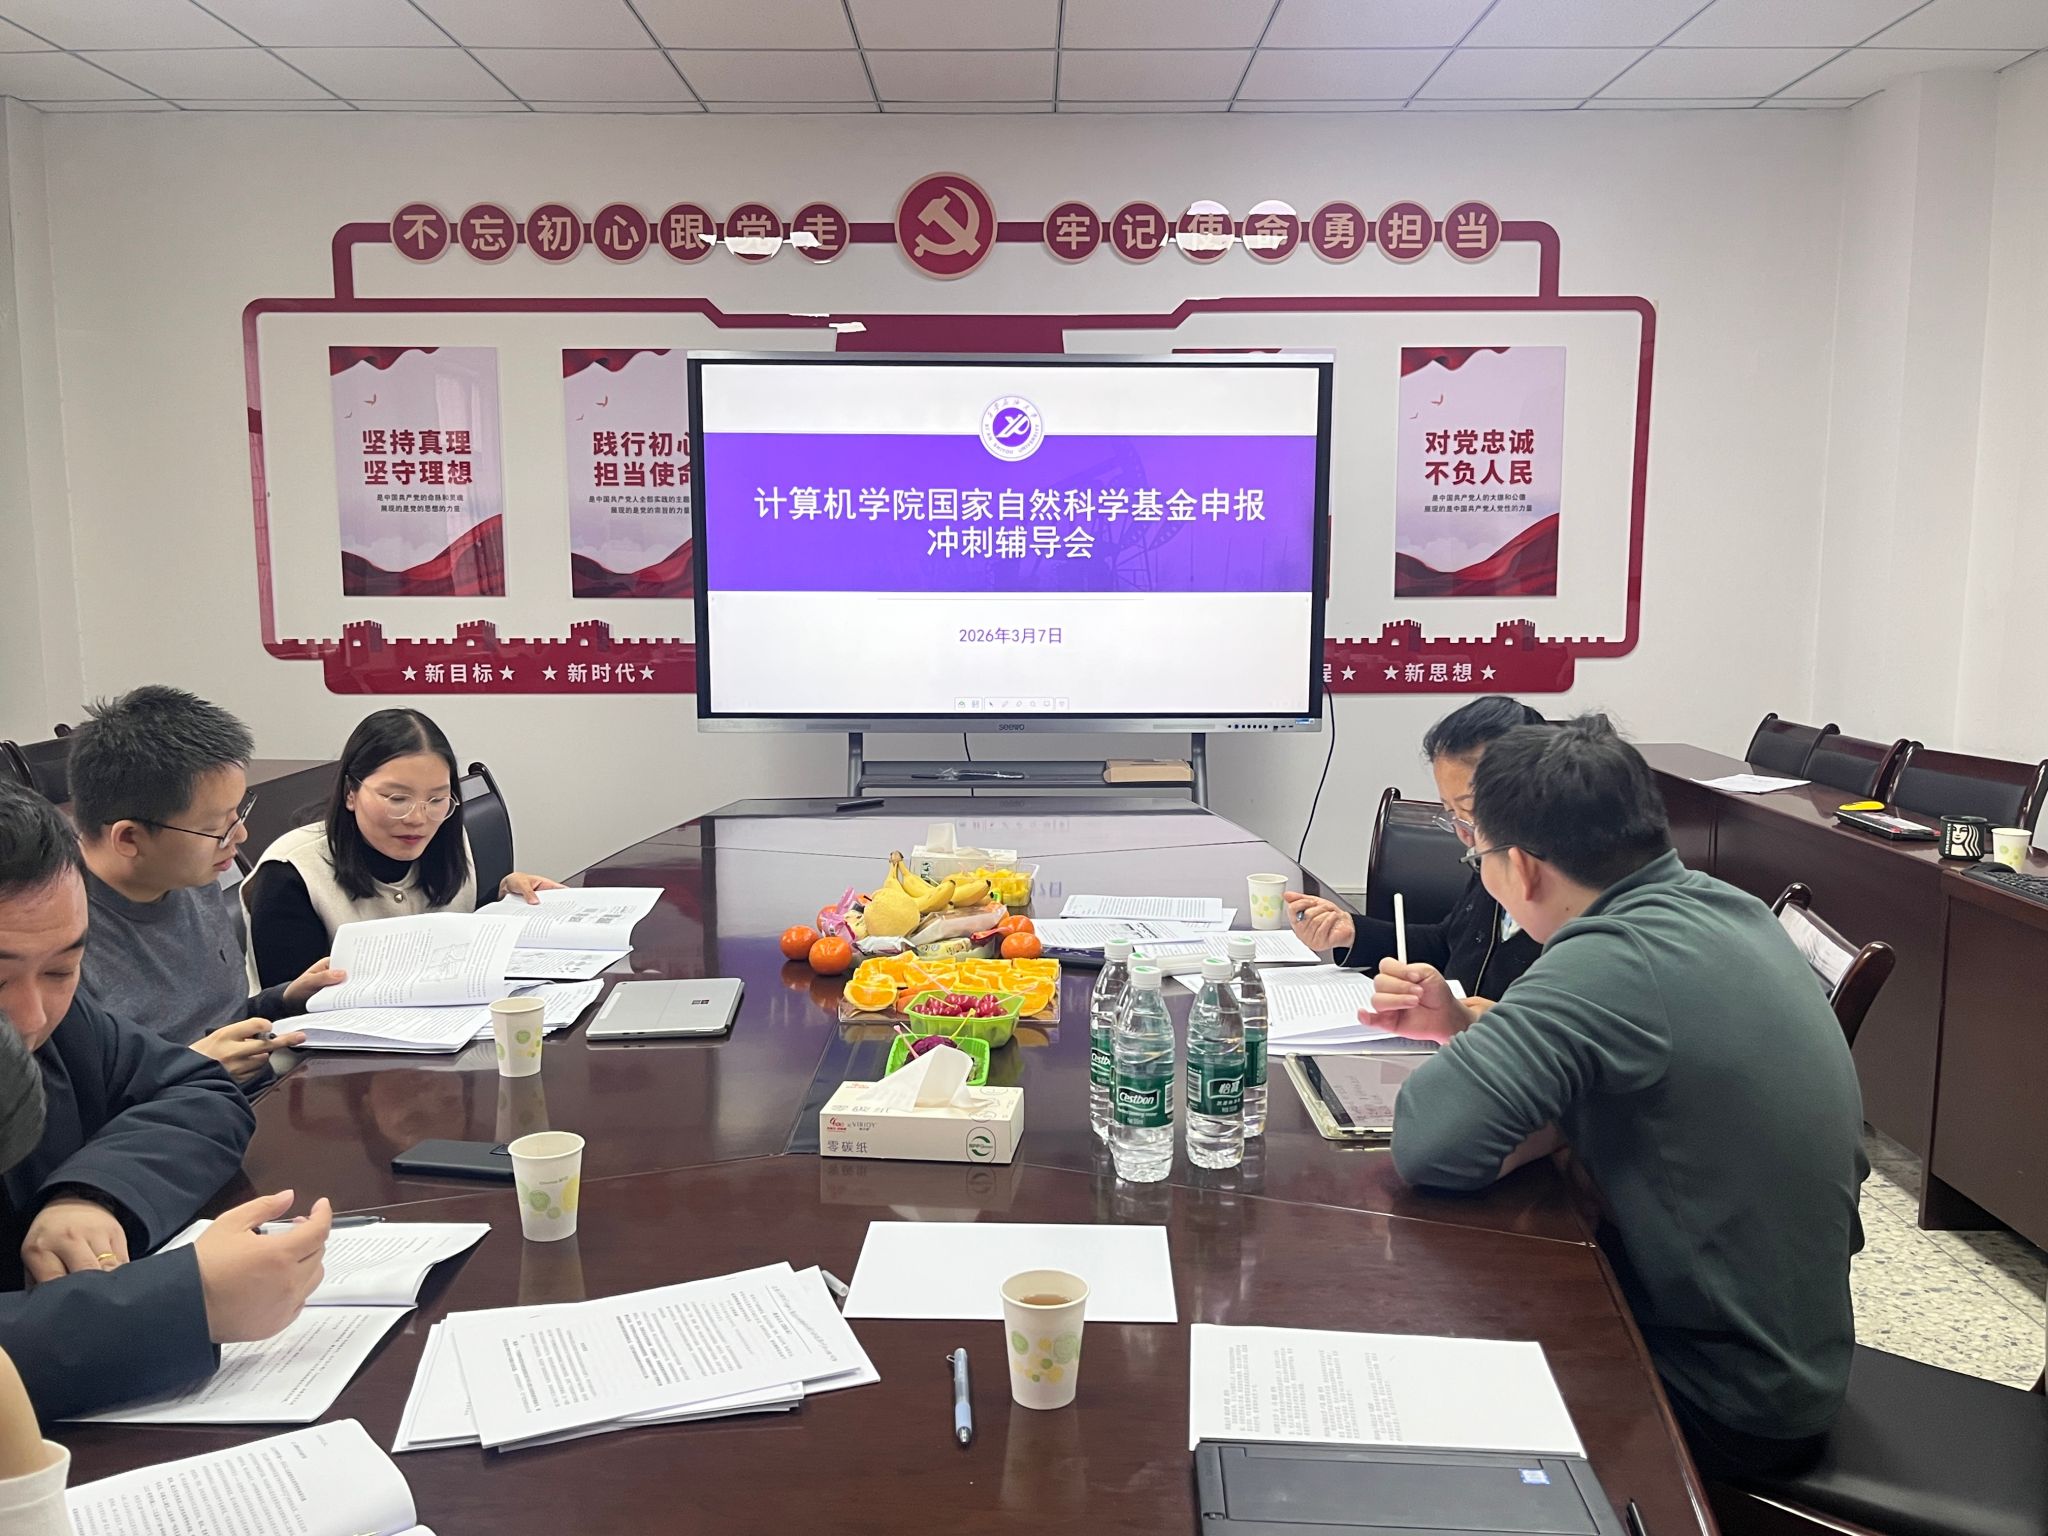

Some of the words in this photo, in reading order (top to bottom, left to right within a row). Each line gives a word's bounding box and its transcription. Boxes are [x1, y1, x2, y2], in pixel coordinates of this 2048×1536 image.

[362, 429, 472, 455] 坚持真理
[1424, 429, 1535, 456] 对党忠诚
[364, 459, 473, 485] 坚守理想
[1424, 459, 1533, 486] 不负人民
[753, 485, 1267, 523] 计算机学院国家自然科学基金申报
[926, 525, 1096, 560] 冲刺辅导会
[958, 627, 1063, 645] 2026年3月7日
[424, 663, 493, 684] 新目标
[567, 662, 636, 684] 新时代
[1404, 662, 1473, 683] 新思想
